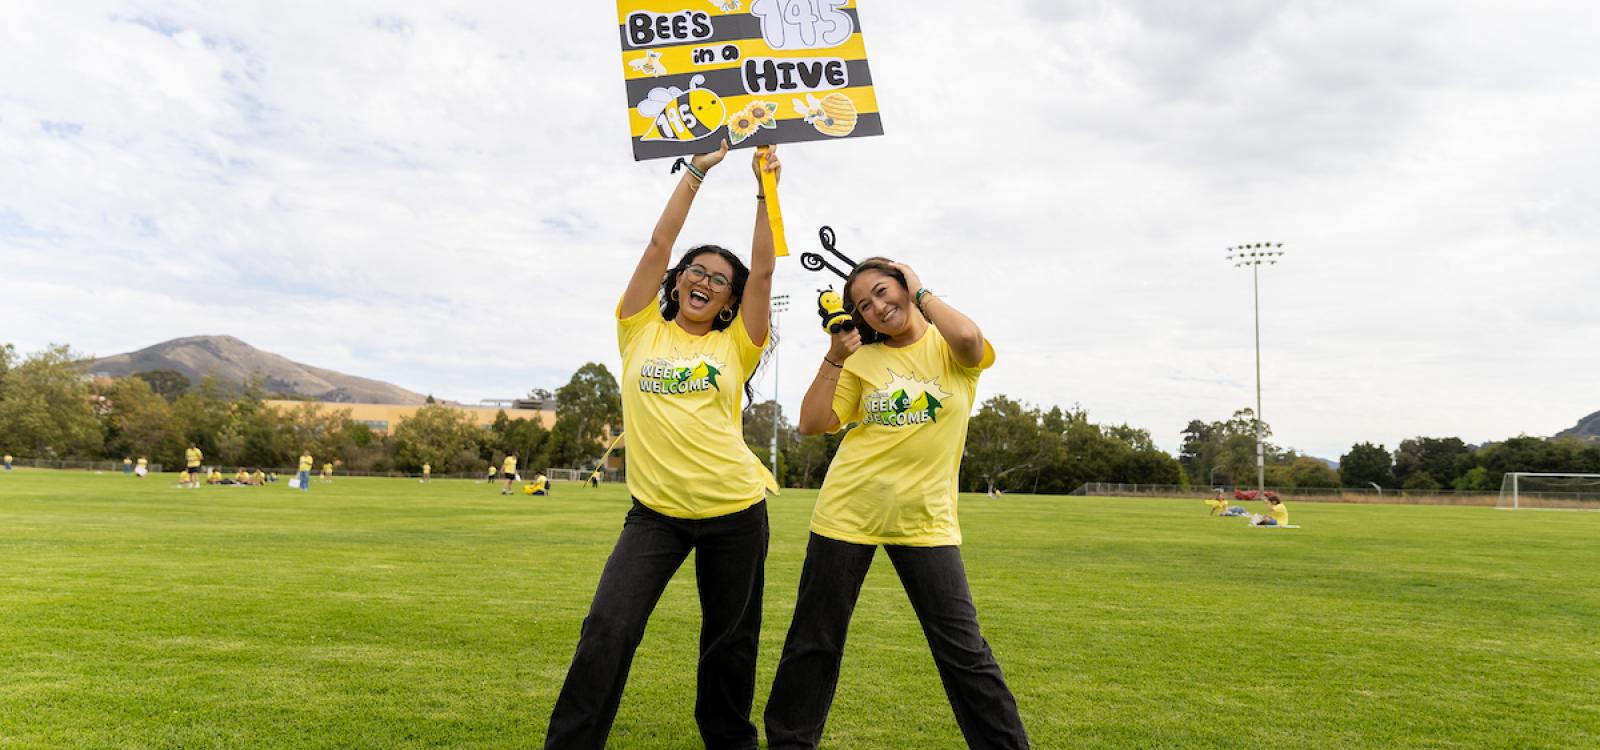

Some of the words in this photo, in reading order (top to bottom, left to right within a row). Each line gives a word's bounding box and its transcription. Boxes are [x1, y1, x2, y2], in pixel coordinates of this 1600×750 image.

[693, 49, 714, 64] in
[721, 44, 739, 60] a
[745, 59, 845, 92] HIVE
[641, 365, 681, 380] WEEK
[639, 377, 710, 394] WELCOME
